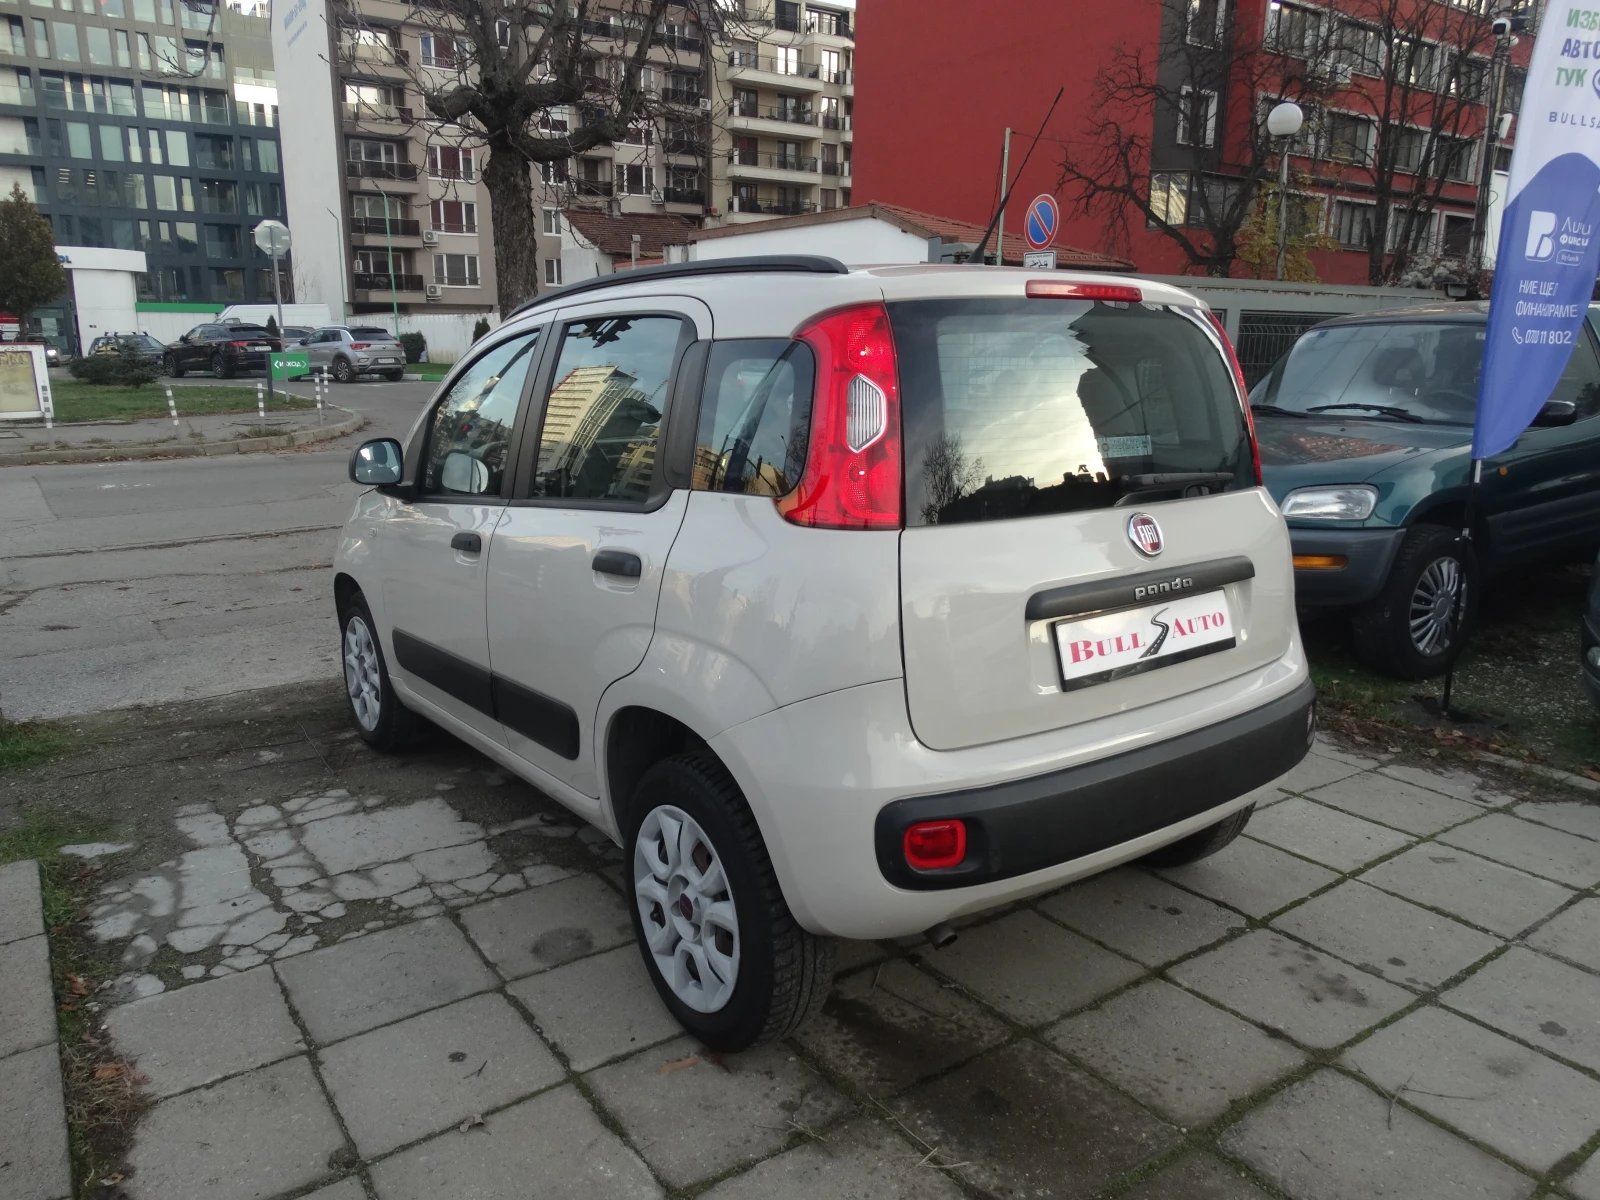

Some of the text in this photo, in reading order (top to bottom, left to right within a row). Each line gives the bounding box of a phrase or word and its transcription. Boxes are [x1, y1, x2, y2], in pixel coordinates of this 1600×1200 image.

[1566, 8, 1600, 31] ИЗБ
[1555, 67, 1588, 87] ТУК
[1519, 279, 1538, 295] НИЕ
[1548, 330, 1572, 345] 802
[1138, 524, 1158, 544] FIAT
[1134, 577, 1193, 600] panda
[1068, 632, 1146, 664] BULL
[1171, 611, 1225, 639] AUTO
